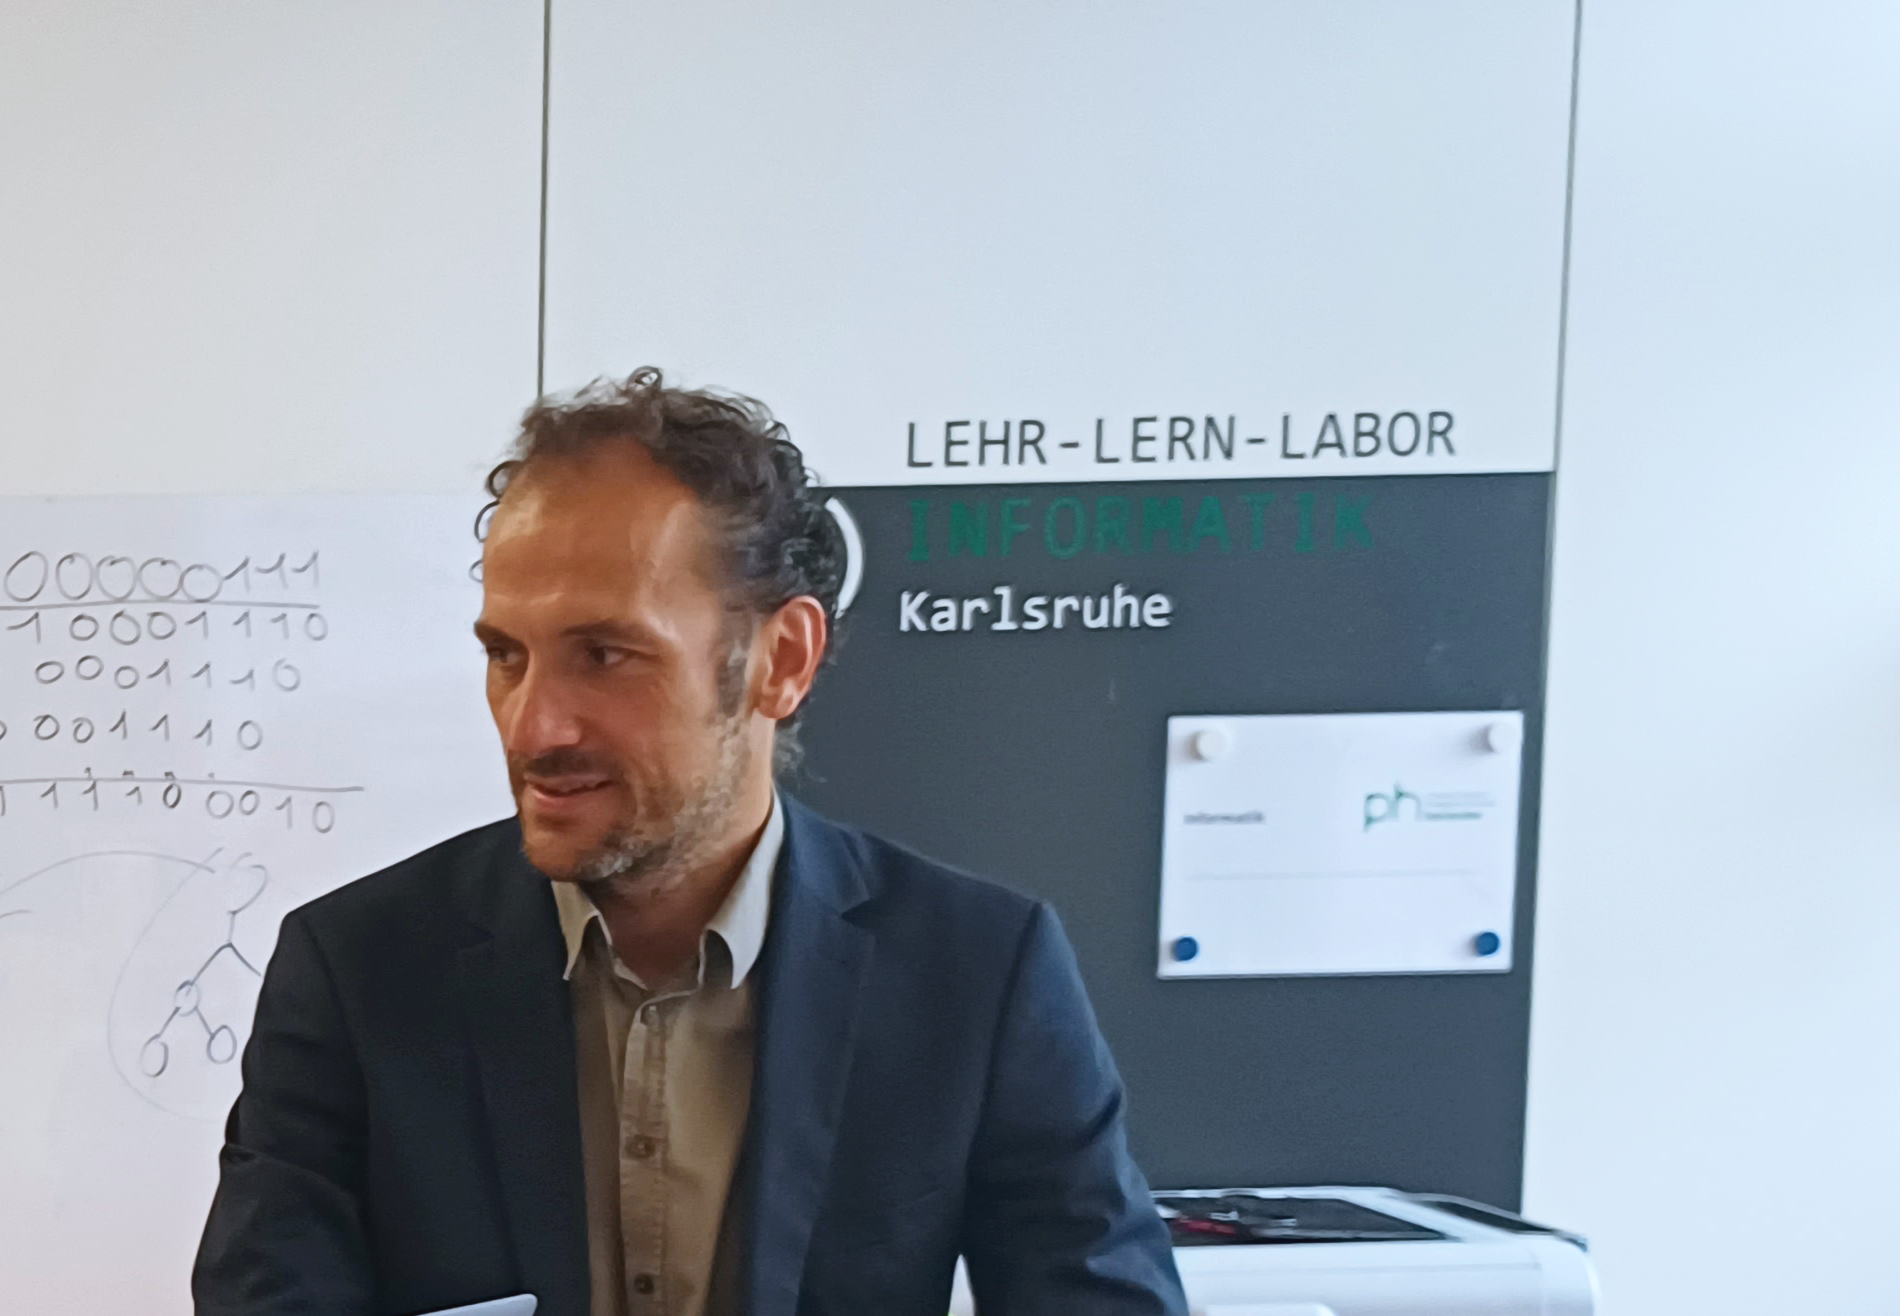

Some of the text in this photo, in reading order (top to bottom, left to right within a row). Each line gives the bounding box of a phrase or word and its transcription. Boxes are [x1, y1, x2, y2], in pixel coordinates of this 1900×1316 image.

[906, 410, 1456, 468] LEHR-LERN-LABOR
[907, 491, 1376, 561] INFORMATIK
[899, 584, 1172, 633] Karlsruhe
